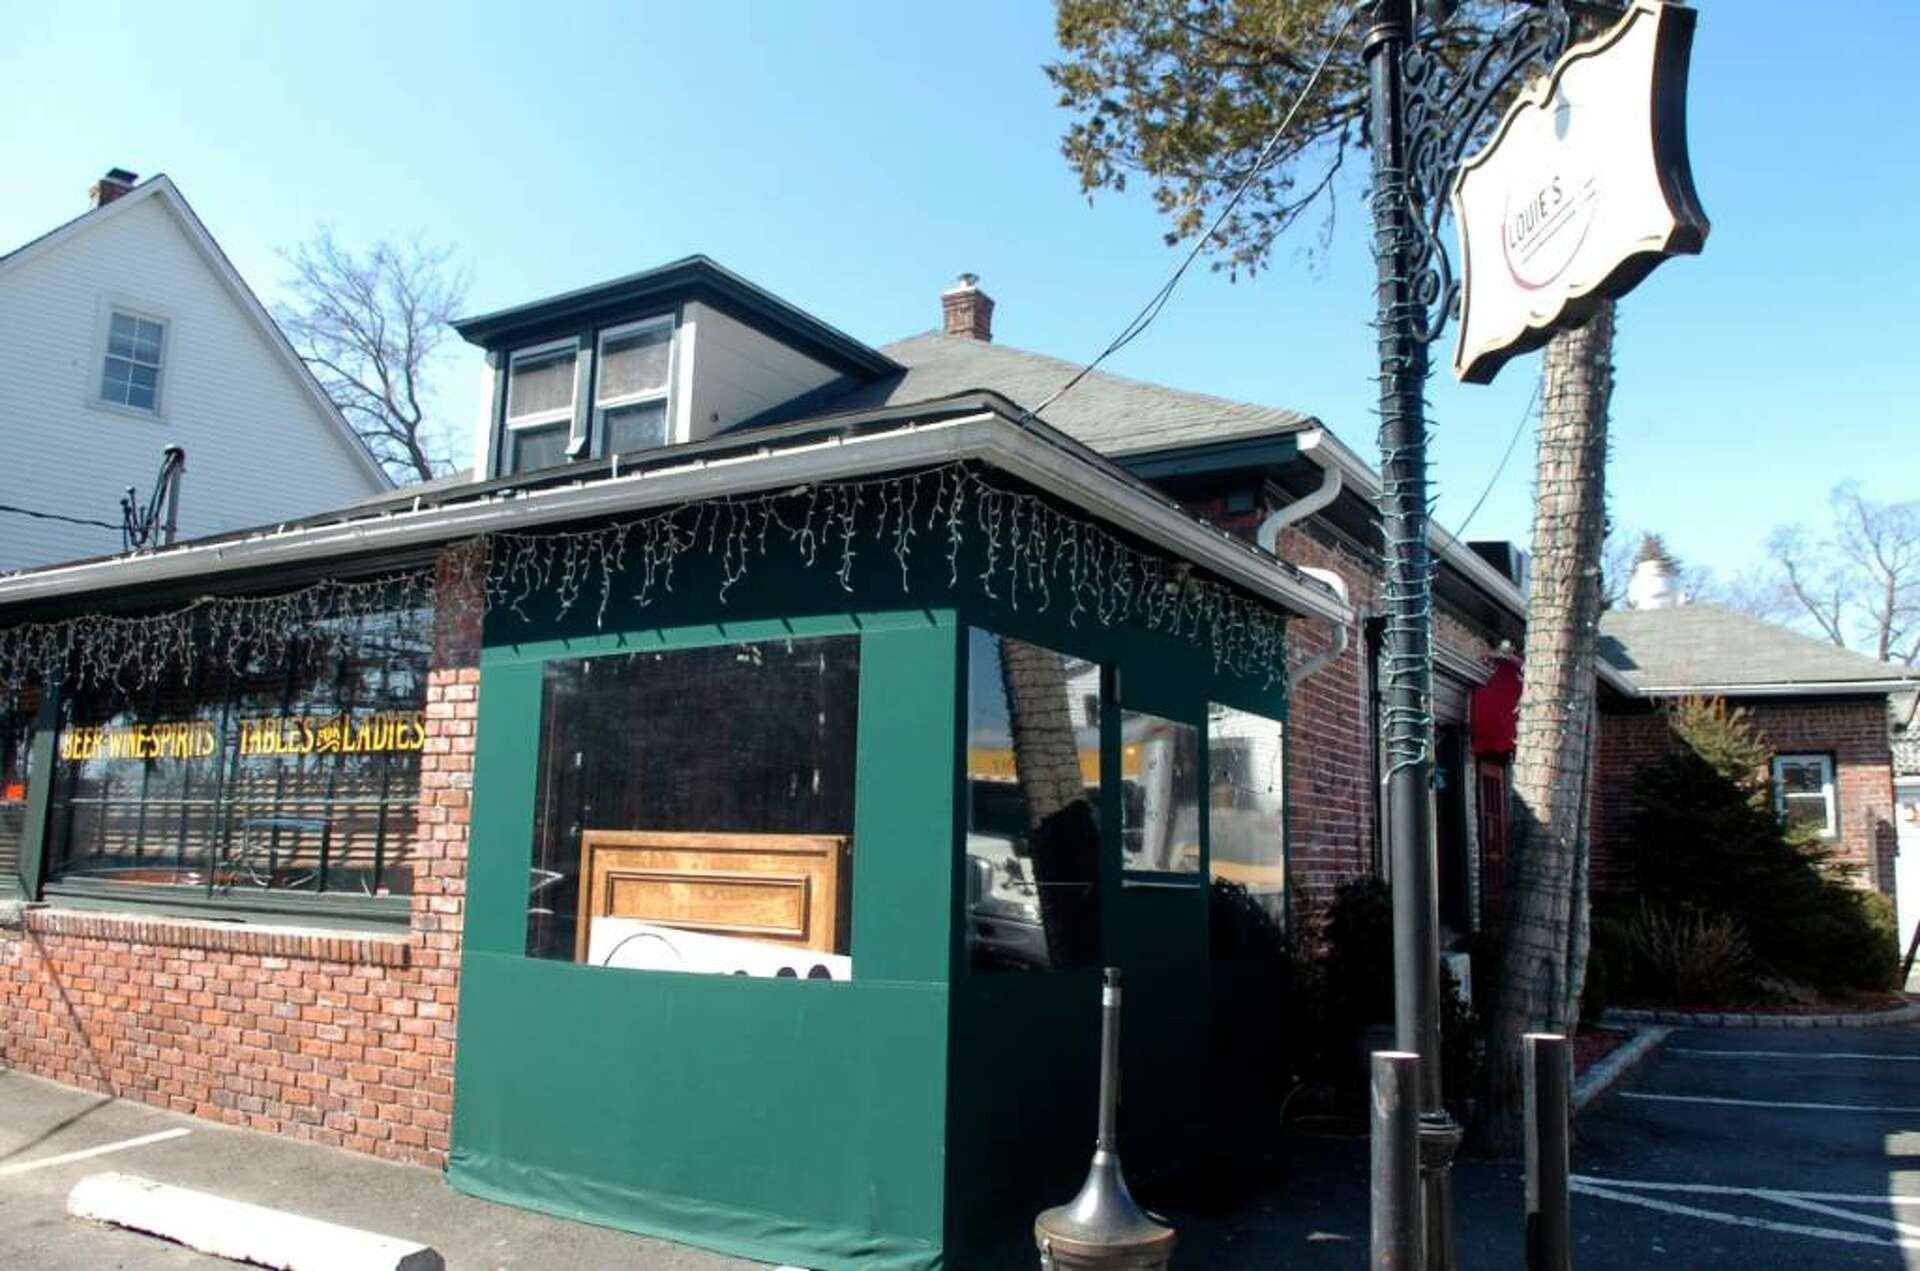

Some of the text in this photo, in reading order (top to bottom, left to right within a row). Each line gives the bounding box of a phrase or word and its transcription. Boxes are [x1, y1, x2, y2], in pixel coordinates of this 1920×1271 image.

[62, 726, 102, 760] BEER
[239, 717, 314, 754] TABLES
[342, 710, 425, 752] LADIES
